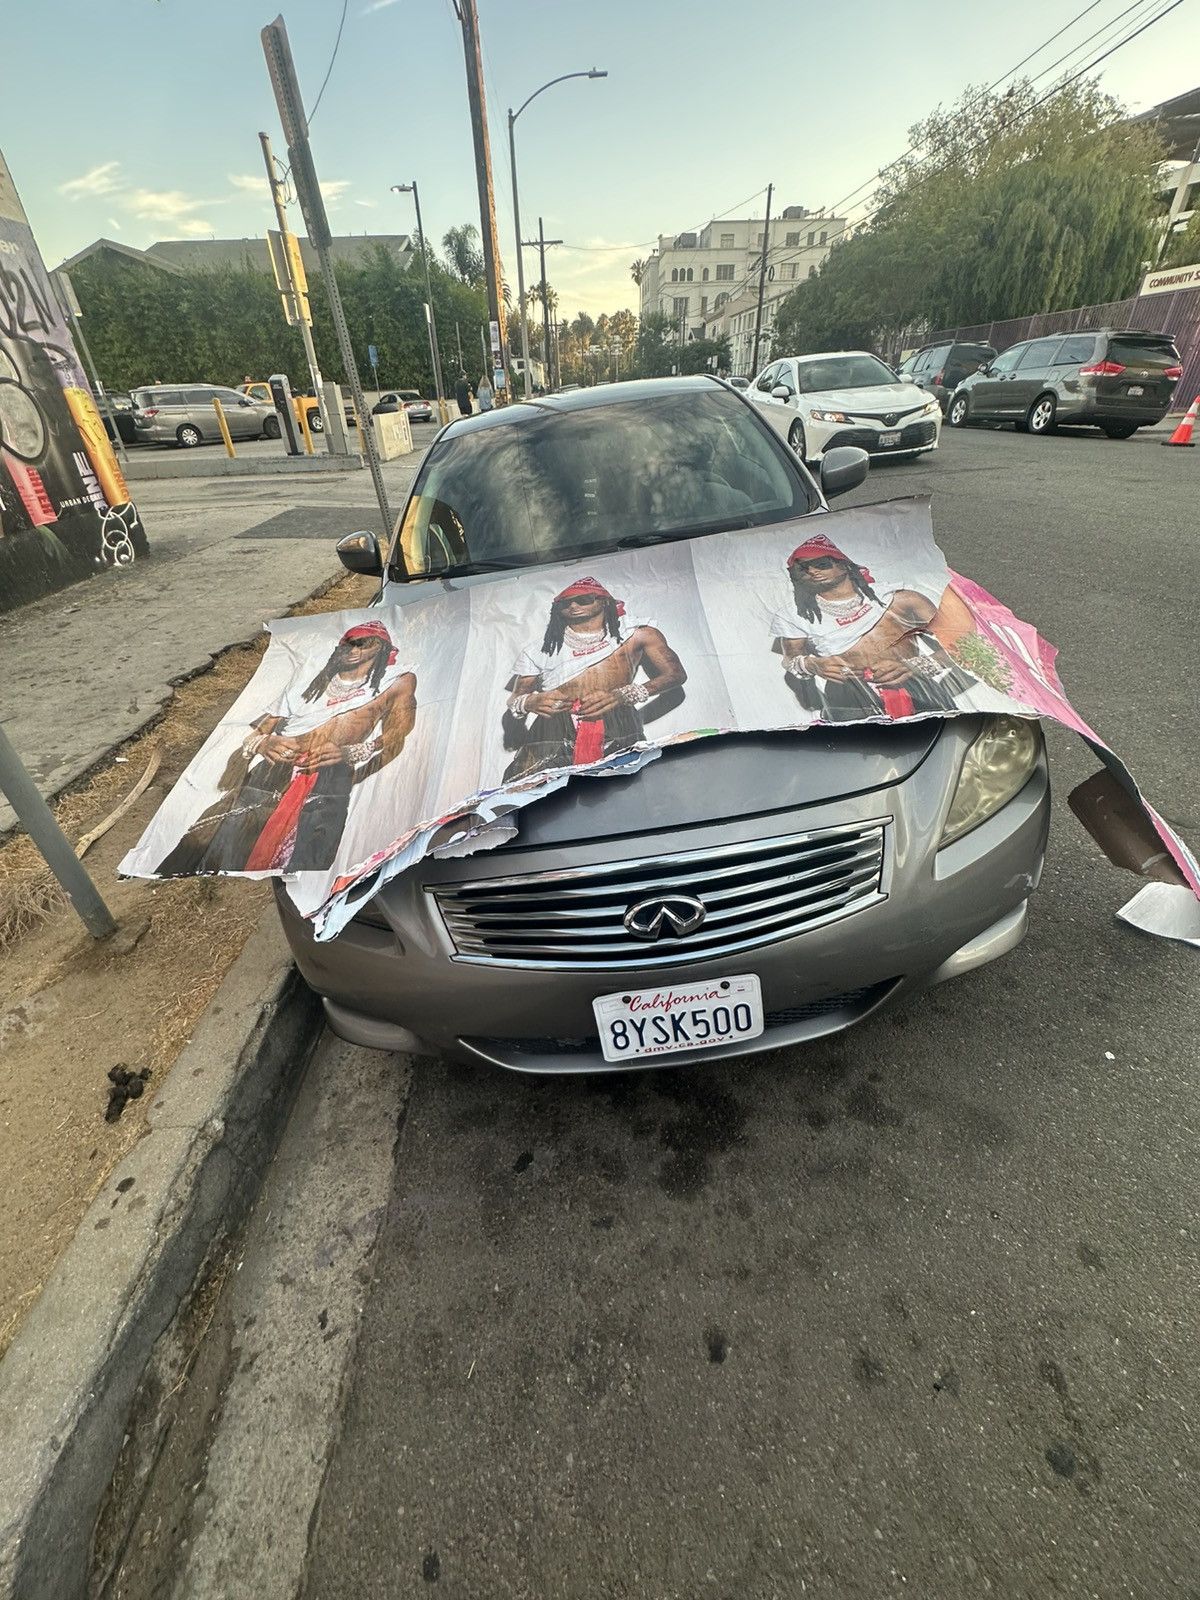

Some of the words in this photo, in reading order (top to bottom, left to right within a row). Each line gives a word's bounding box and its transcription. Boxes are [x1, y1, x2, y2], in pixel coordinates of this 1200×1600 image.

[1149, 271, 1195, 288] COMMUNITY
[60, 498, 82, 508] URBAN
[629, 987, 730, 1012] California
[610, 1003, 752, 1050] 8YSK500
[644, 1036, 725, 1053] dmv.ca.gov
